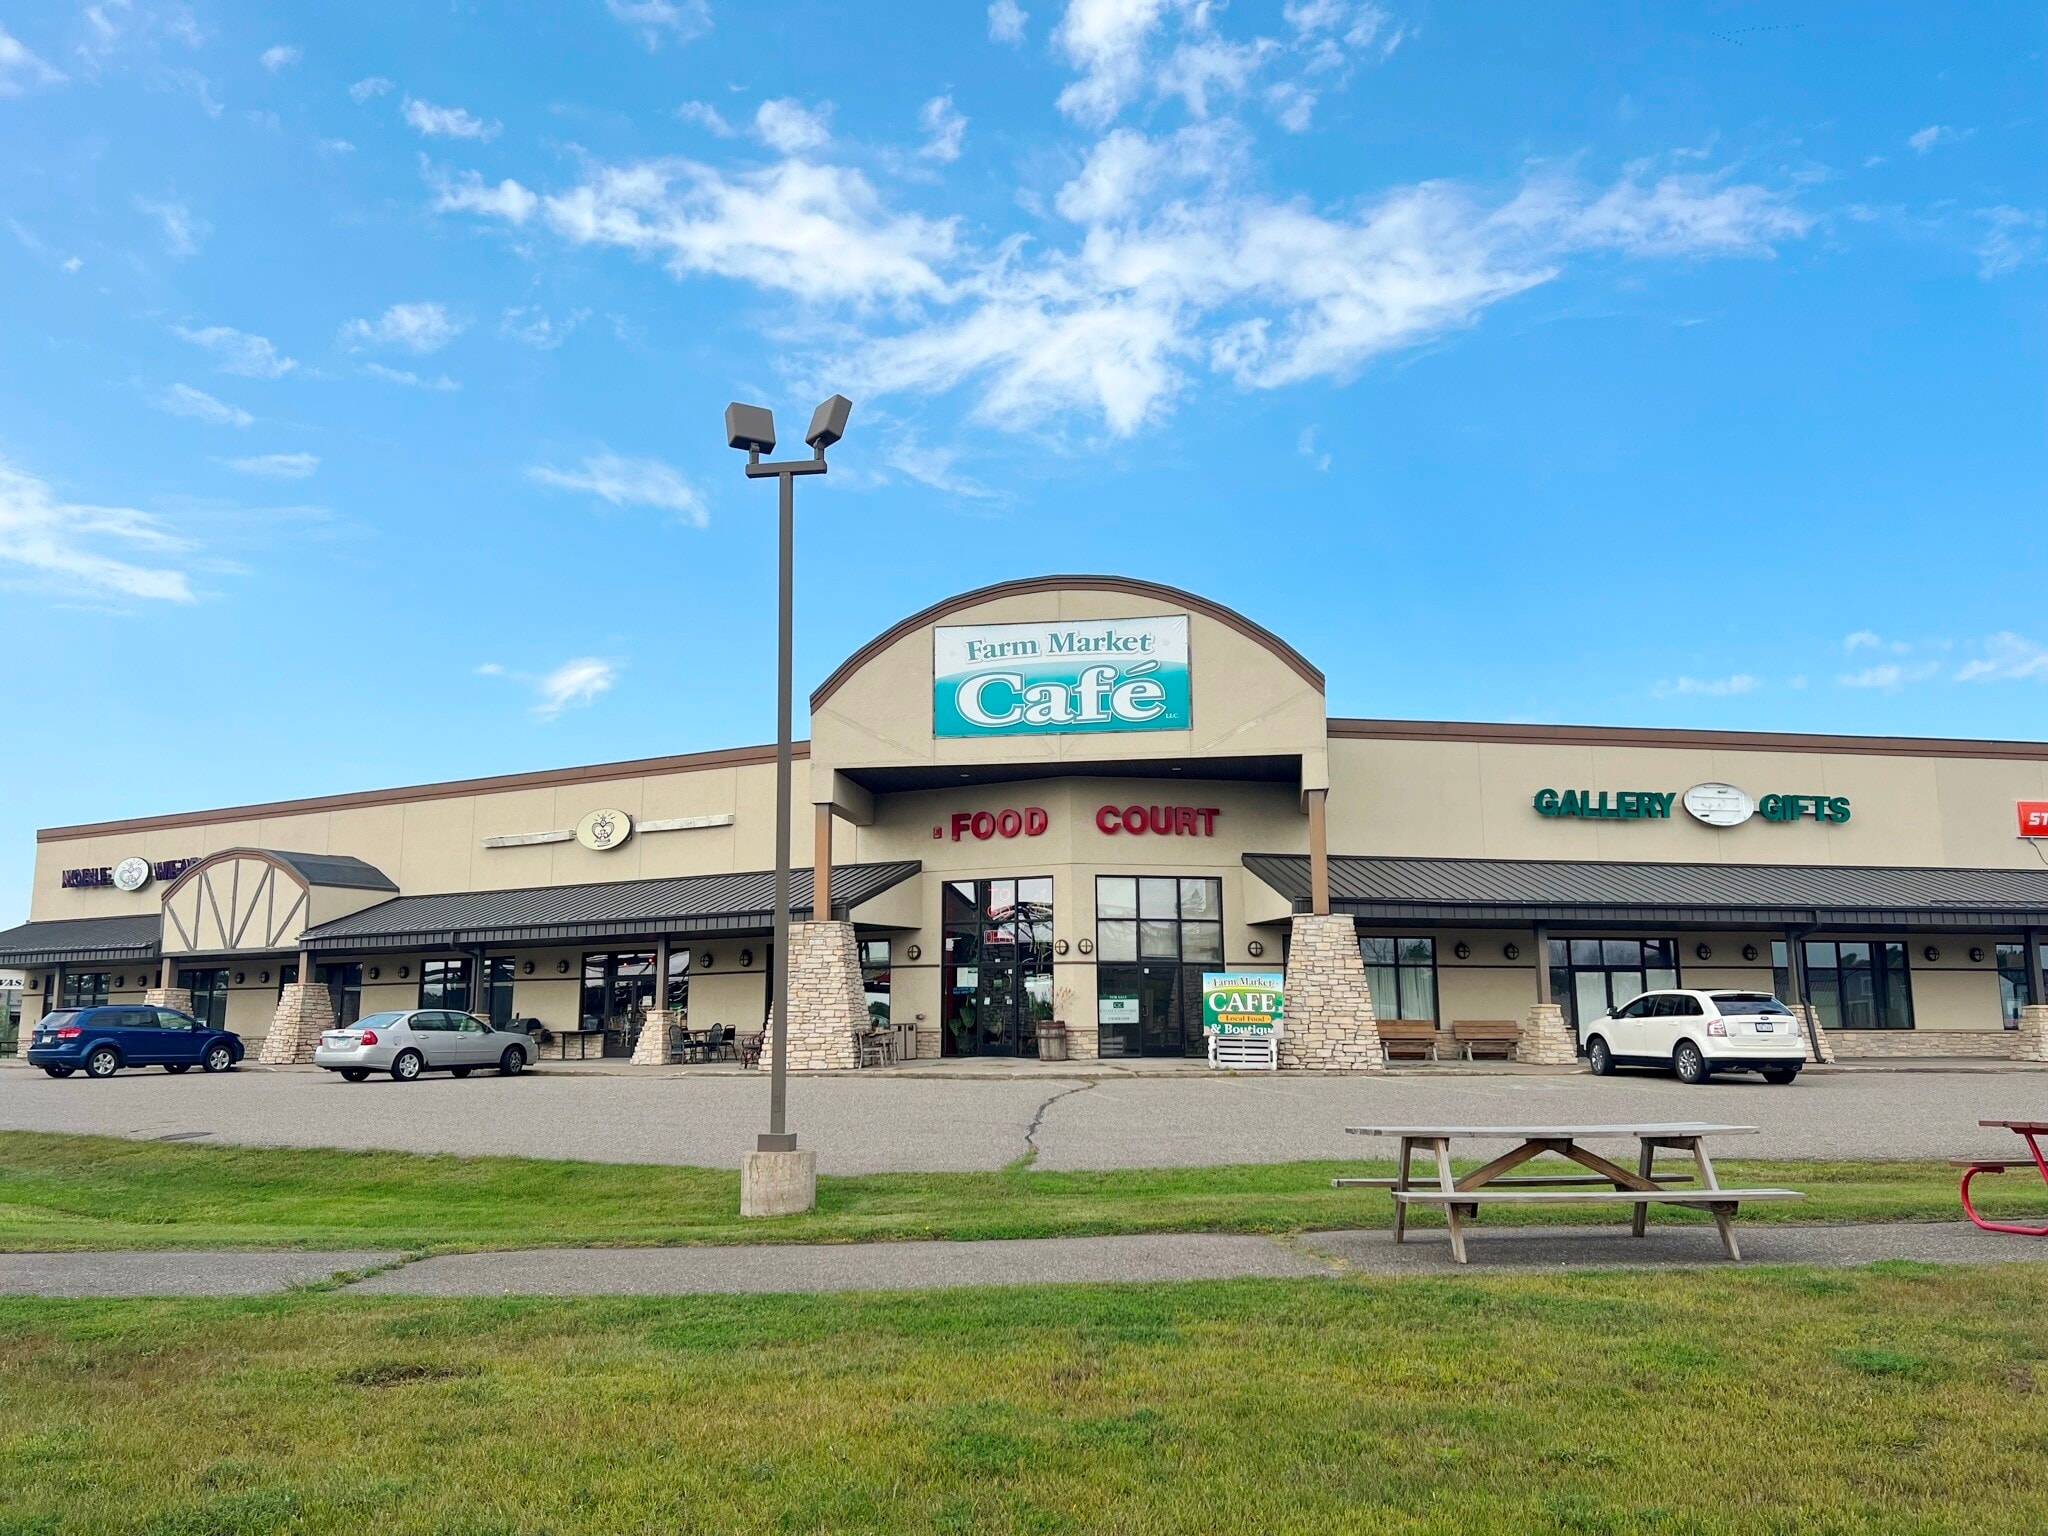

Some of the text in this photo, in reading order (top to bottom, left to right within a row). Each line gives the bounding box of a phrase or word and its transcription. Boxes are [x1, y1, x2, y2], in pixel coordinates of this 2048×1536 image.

[966, 631, 1152, 661] Farm Market
[956, 659, 1166, 727] Café
[1534, 788, 1850, 823] GALLERY GIFTS
[951, 805, 1220, 841] FOOD COURT
[1213, 977, 1274, 987] Farm Market
[1208, 992, 1275, 1013] CAFE
[1210, 1023, 1274, 1035] & Boutiqu
